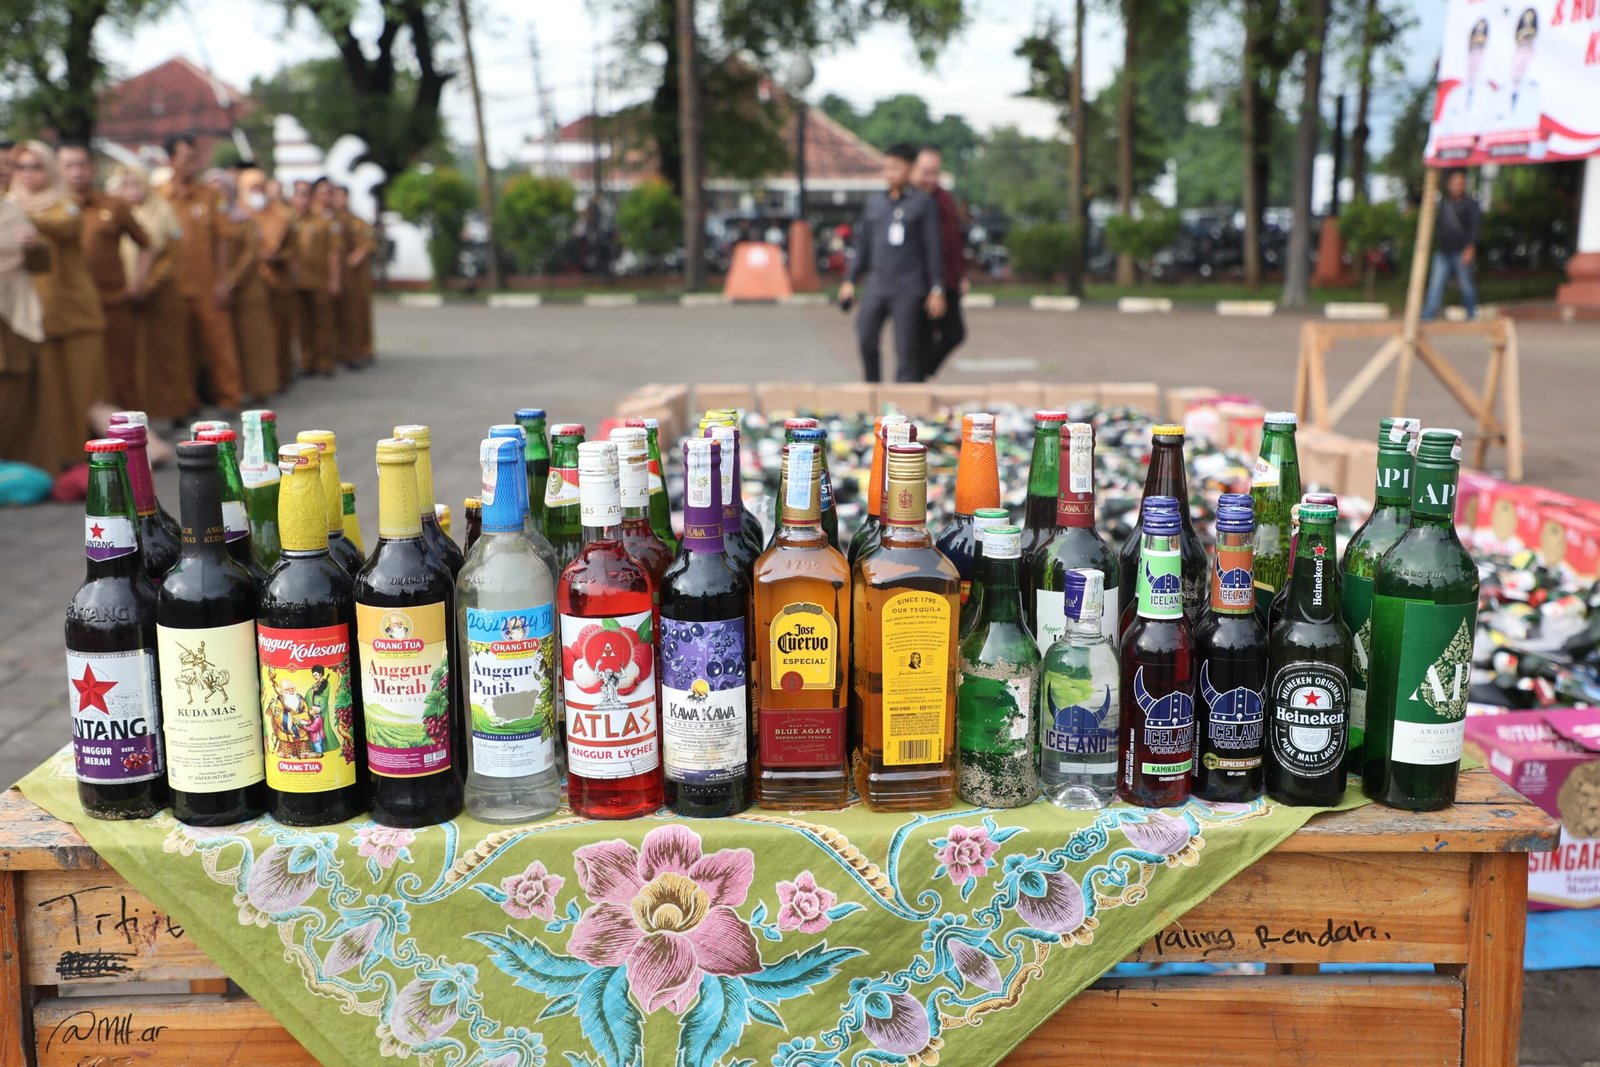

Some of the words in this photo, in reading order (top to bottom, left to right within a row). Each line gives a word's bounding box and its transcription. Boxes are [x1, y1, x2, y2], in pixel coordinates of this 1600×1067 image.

[1418, 483, 1456, 505] AP
[1060, 502, 1080, 513] KAWA
[686, 527, 706, 537] KAWA
[1311, 558, 1325, 606] Heineken
[897, 597, 919, 605] SINCE
[794, 624, 815, 636] Jose
[374, 640, 402, 649] ORANG
[493, 643, 521, 651] ORANG
[777, 632, 828, 654] Cuervo
[289, 643, 346, 662] Kolesom
[369, 659, 432, 681] Anggur
[472, 660, 532, 681] Anggur
[373, 678, 427, 695] Merah
[1281, 677, 1312, 700] HEINEKEN
[1315, 677, 1342, 702] ORIGINAL
[177, 708, 208, 717] KUDA
[211, 705, 237, 716] MAS
[670, 702, 700, 721] KAWA
[702, 706, 736, 721] KAWA
[1276, 706, 1345, 725] Heineken
[572, 707, 651, 738] ATLAS
[1045, 729, 1108, 752] ICELAND
[82, 746, 112, 755] ANGGUR
[572, 747, 613, 759] ANGGUR
[618, 743, 653, 758] LYCHEE
[1281, 737, 1297, 757] PURE
[1297, 753, 1318, 762] MALT
[1320, 740, 1339, 760] LAGER
[84, 757, 111, 766] MERAH
[279, 763, 303, 771] ORANG
[1151, 765, 1182, 773] KAMIKAZE
